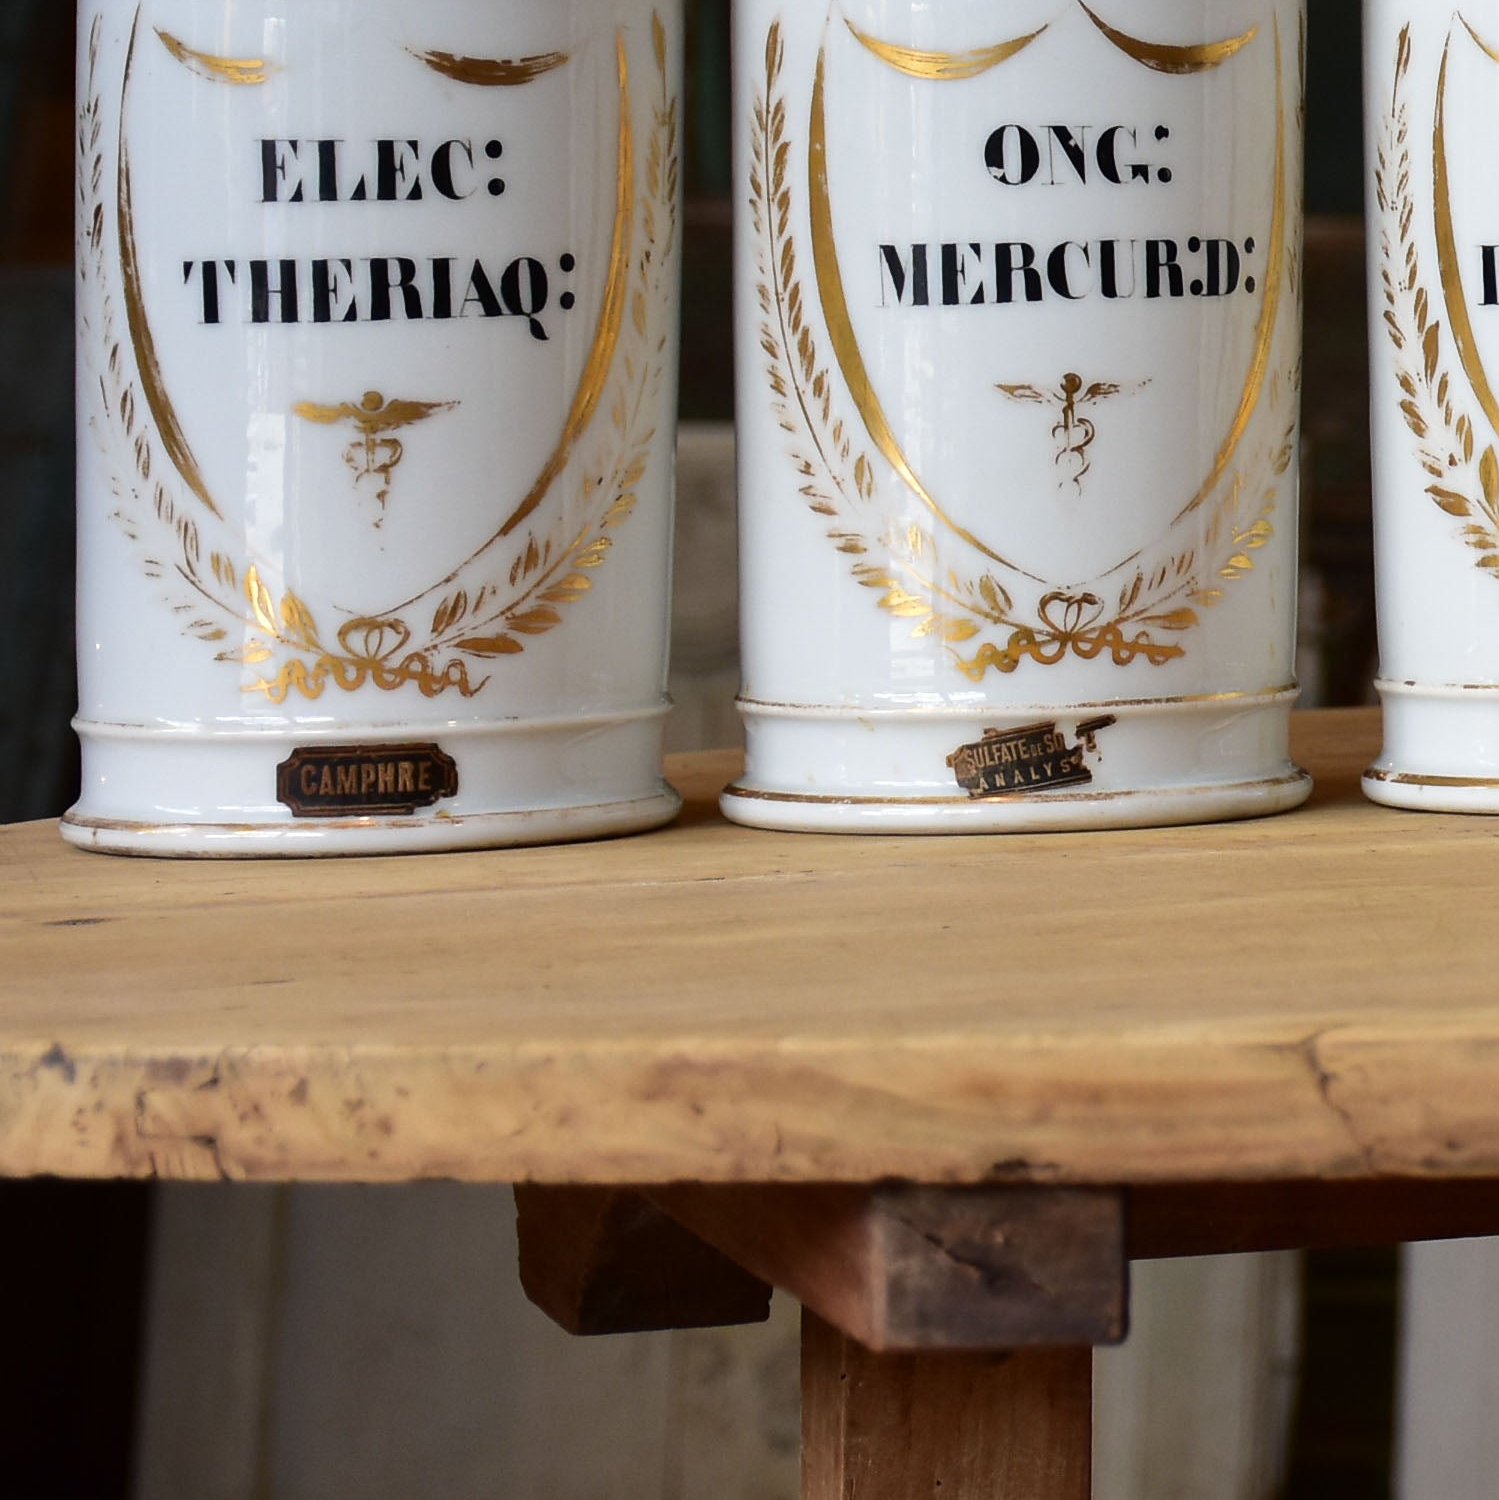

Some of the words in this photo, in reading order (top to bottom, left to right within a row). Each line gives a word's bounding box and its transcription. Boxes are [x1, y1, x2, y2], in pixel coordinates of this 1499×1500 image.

[257, 138, 507, 203] ELEC:
[984, 123, 1174, 187] ONG:
[183, 252, 577, 342] THERIAQ:
[300, 760, 433, 797] CAMPHRE
[965, 738, 1032, 771] SULFATE
[979, 758, 1072, 791] ANALYS
